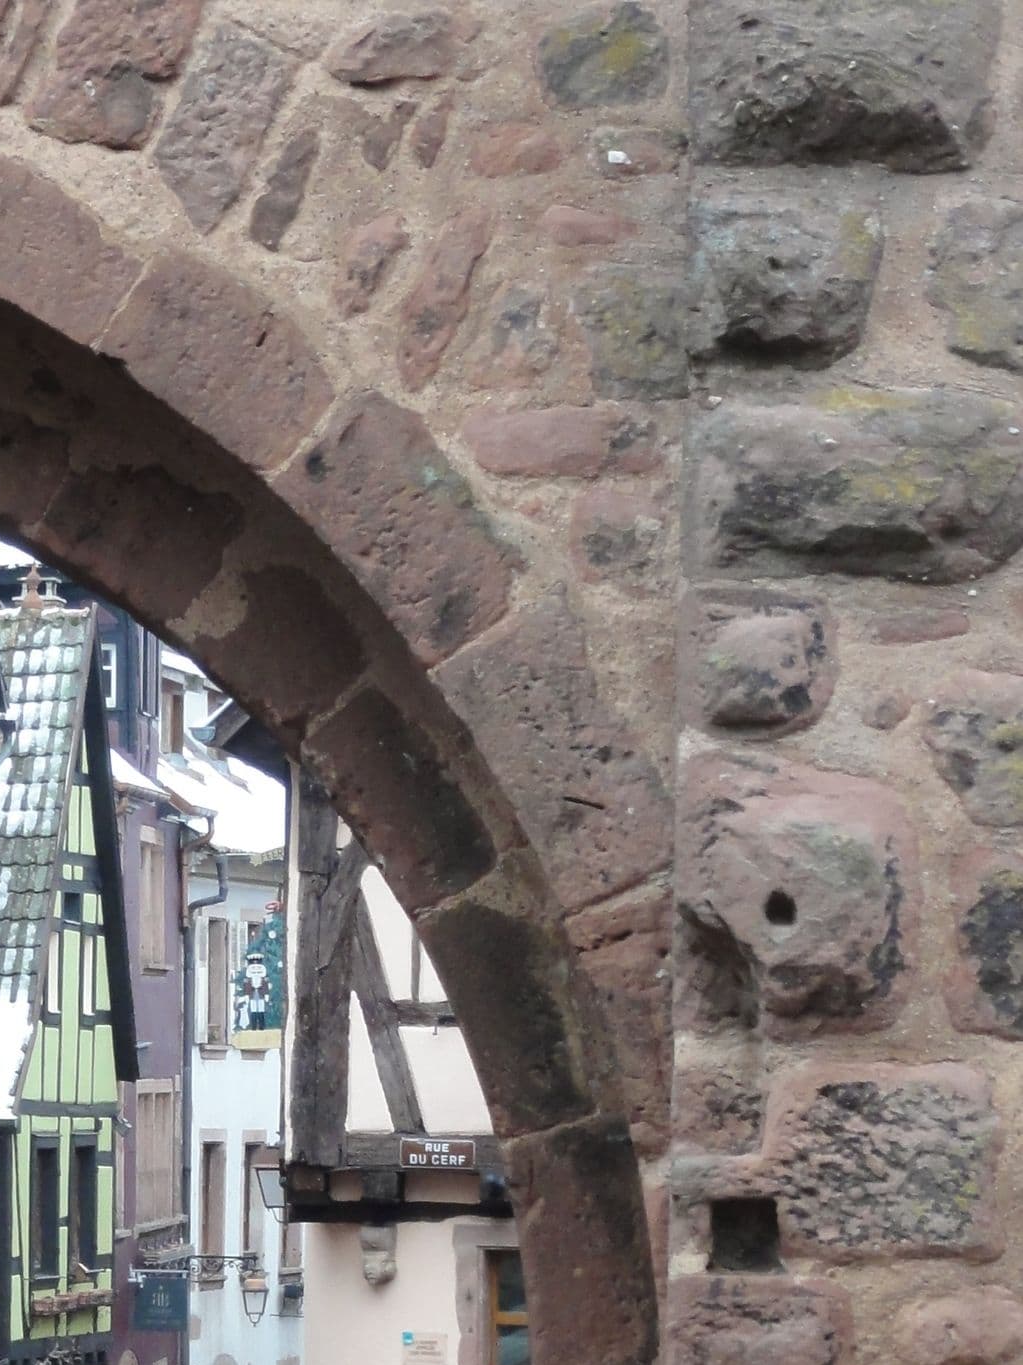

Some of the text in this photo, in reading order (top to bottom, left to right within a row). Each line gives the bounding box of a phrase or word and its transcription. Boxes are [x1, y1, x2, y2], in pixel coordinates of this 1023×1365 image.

[425, 1143, 450, 1152] RUE
[409, 1153, 467, 1166] DU CERF
